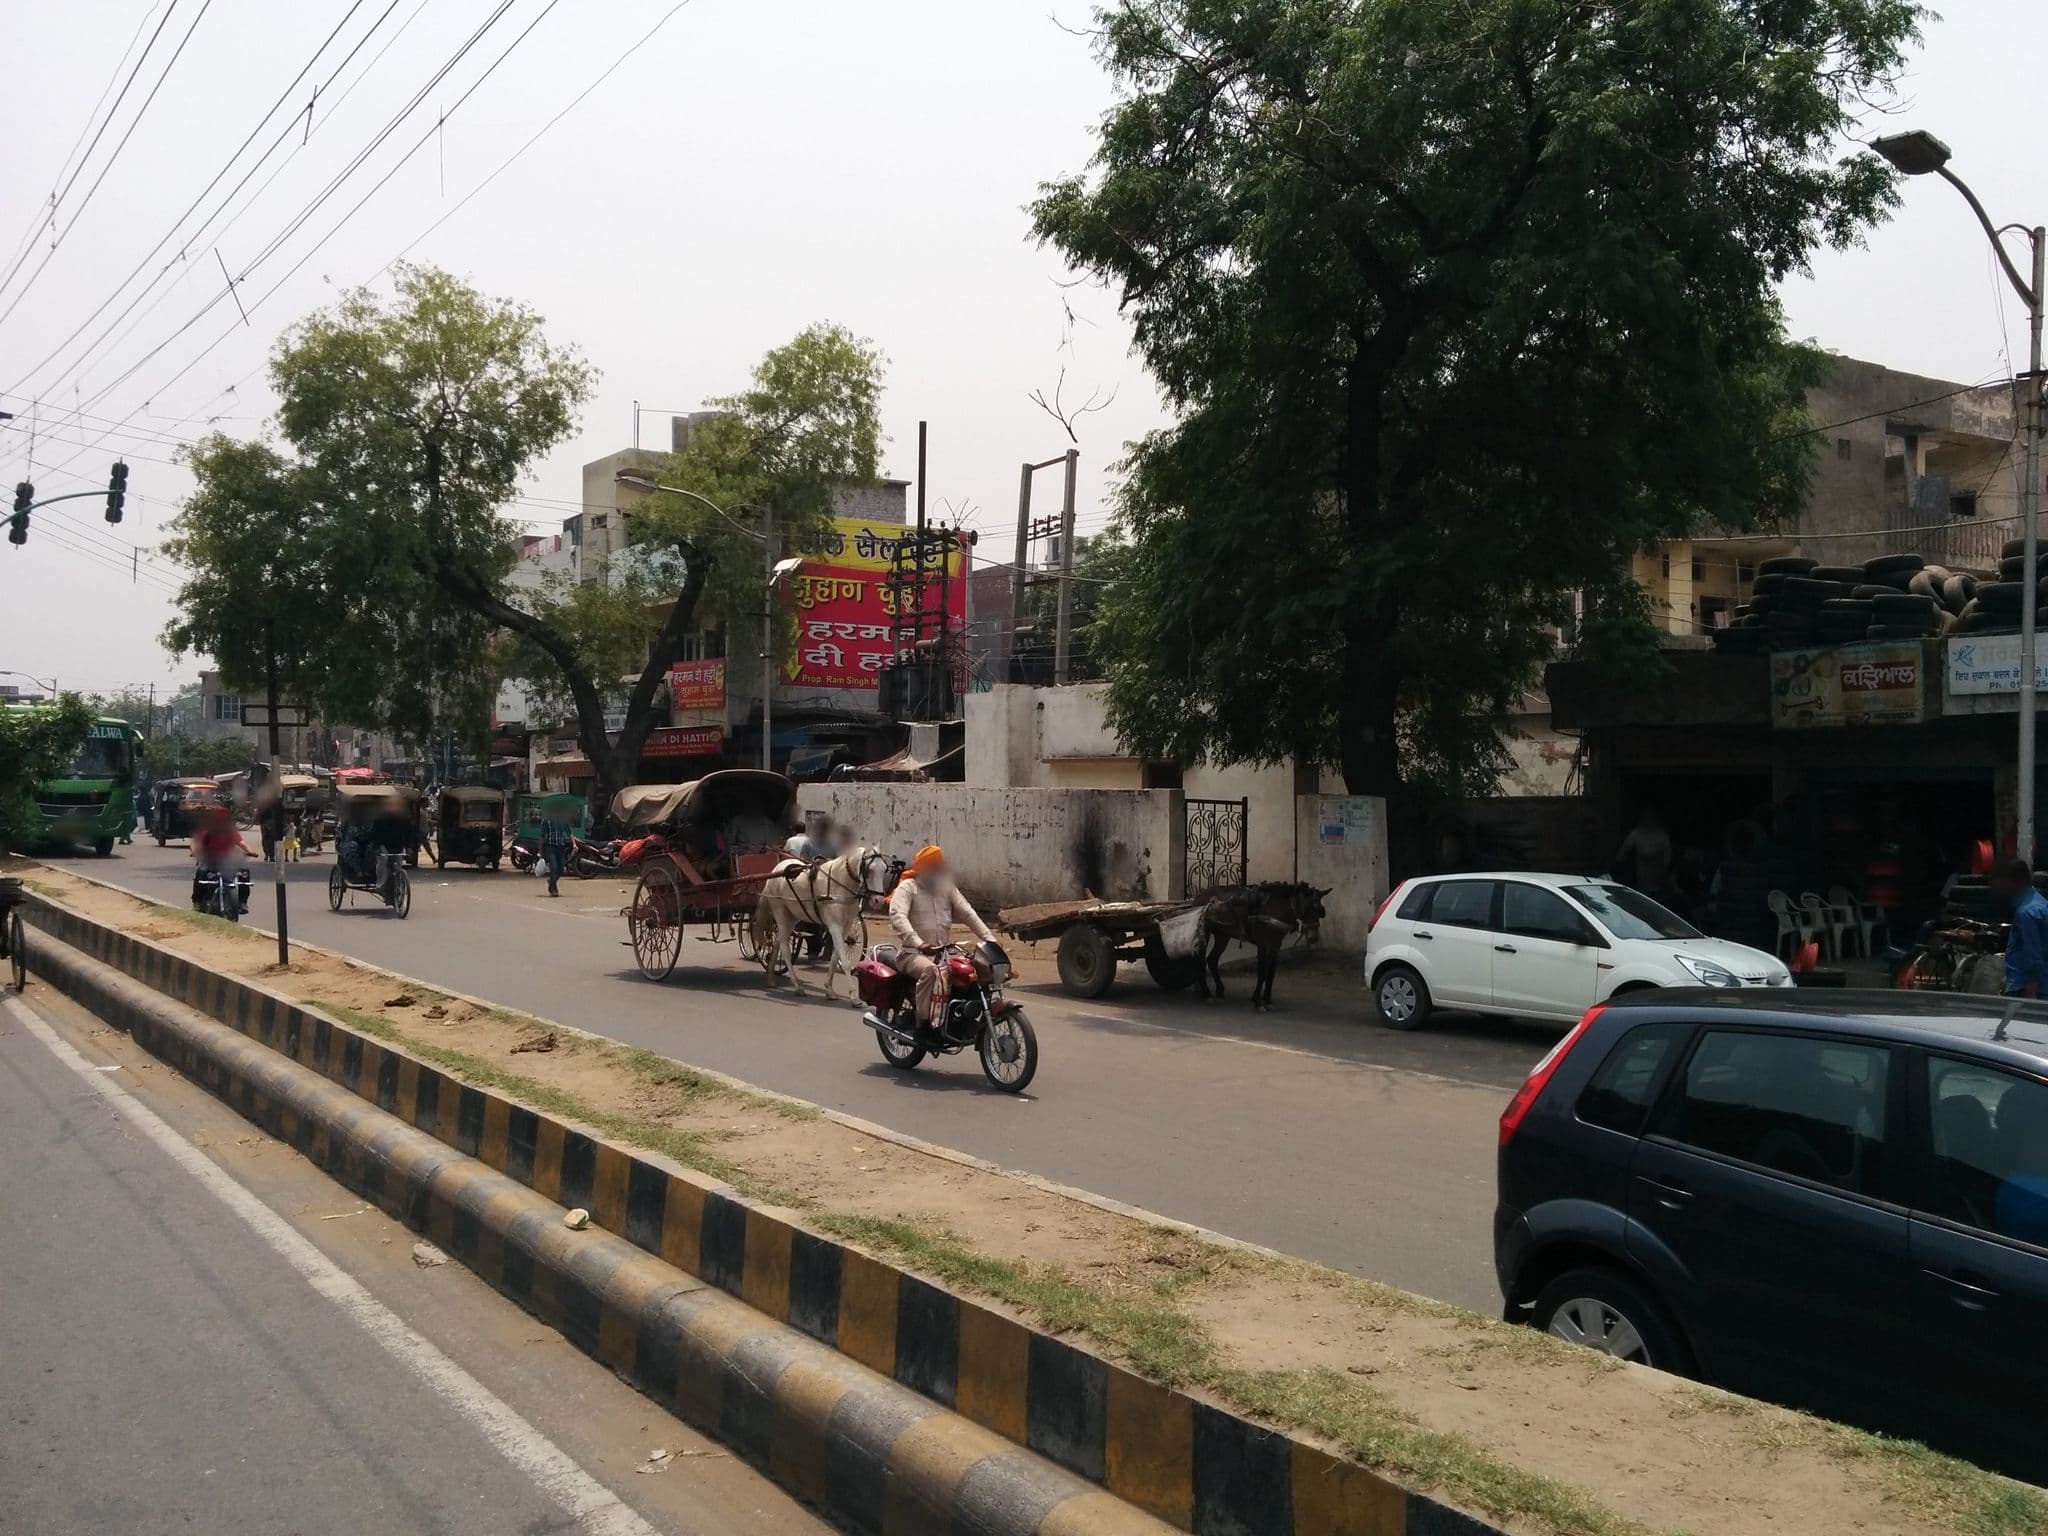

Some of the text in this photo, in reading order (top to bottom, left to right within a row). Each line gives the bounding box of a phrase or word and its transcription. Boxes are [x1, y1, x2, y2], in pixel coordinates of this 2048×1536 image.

[805, 643, 844, 667] दी
[826, 676, 844, 684] Ram
[847, 677, 869, 686] Singh
[670, 735, 680, 744] DI
[682, 734, 709, 744] HATTI
